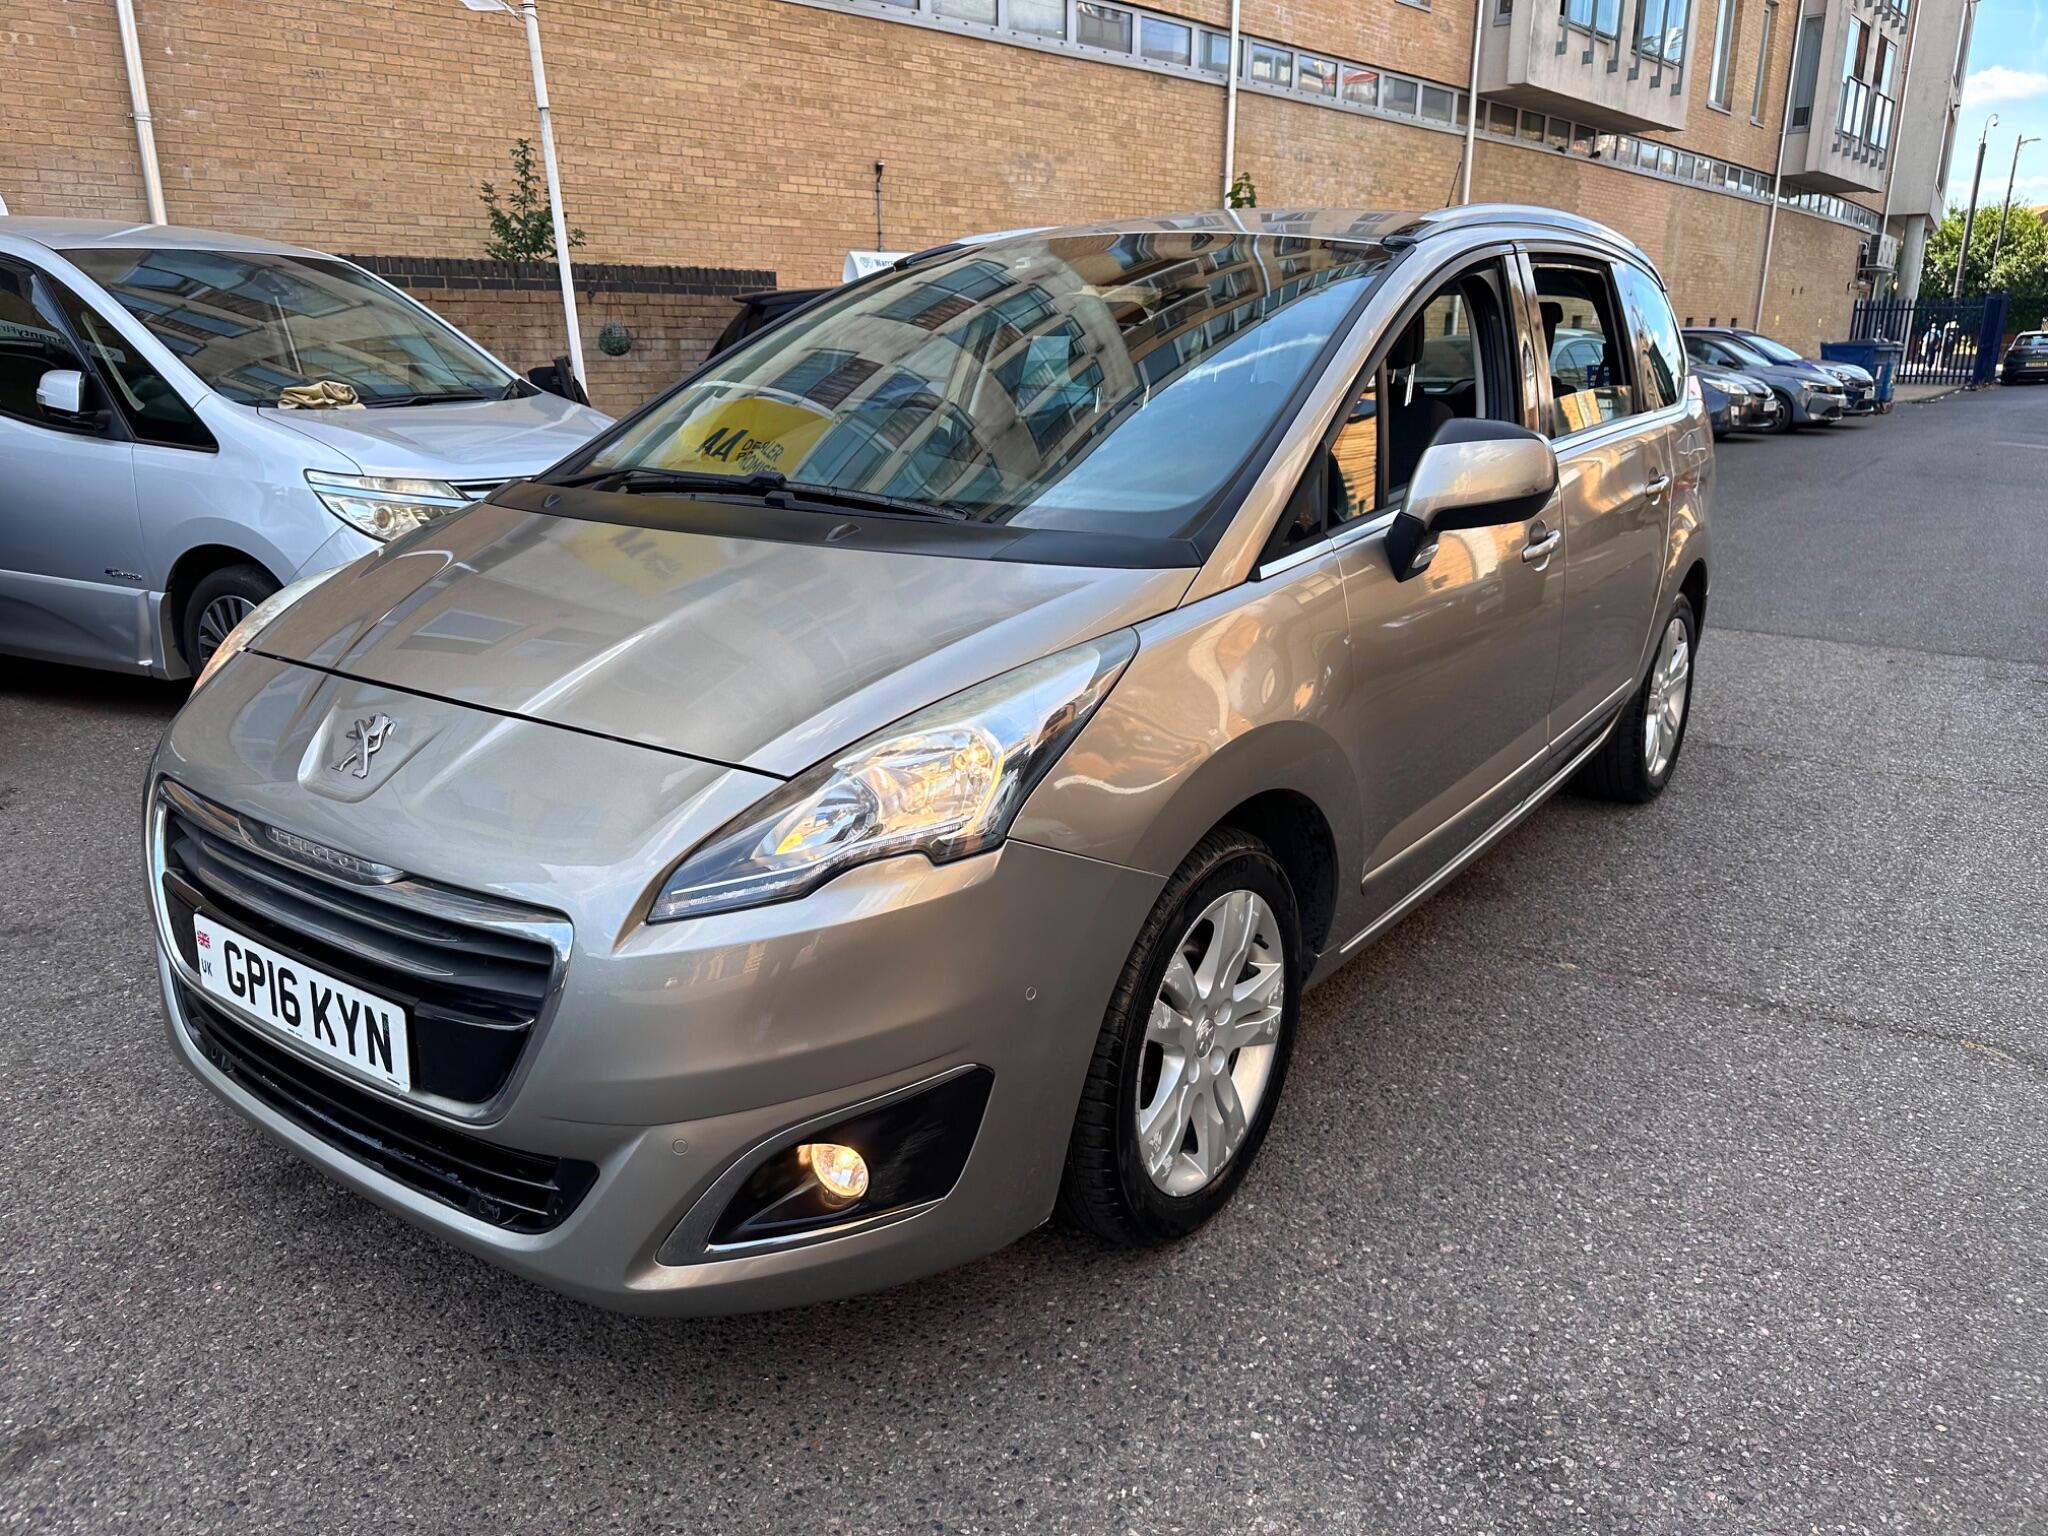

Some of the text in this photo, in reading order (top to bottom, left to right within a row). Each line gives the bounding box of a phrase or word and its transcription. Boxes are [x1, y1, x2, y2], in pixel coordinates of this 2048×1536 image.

[694, 427, 749, 462] AA
[201, 958, 213, 977] UK
[224, 939, 393, 1075] GP16 KYN
